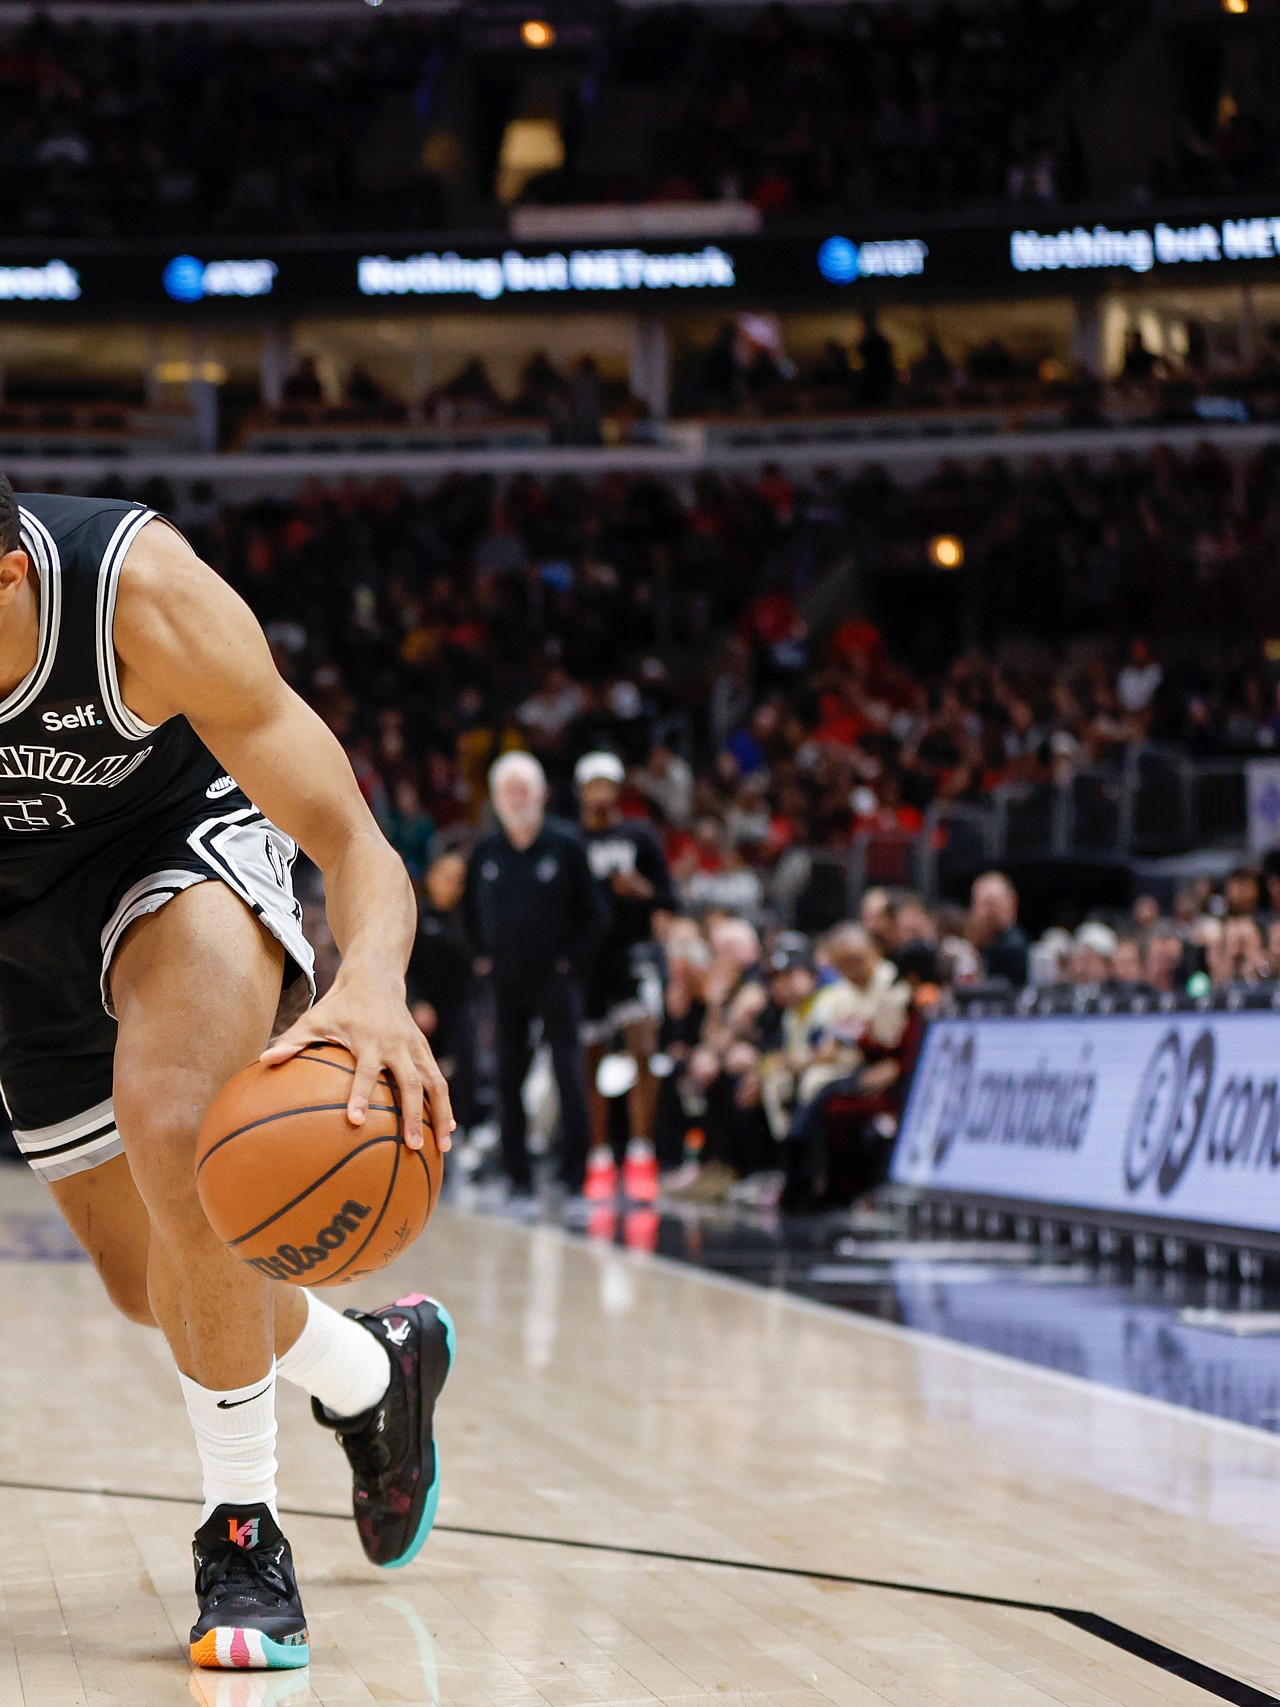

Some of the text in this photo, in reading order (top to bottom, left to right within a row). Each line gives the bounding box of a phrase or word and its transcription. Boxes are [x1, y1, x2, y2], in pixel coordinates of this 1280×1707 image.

[1011, 224, 1154, 272] Nothing
[1154, 223, 1221, 263] but
[358, 246, 735, 299] Nothing but NETwork
[210, 775, 237, 792] NIK
